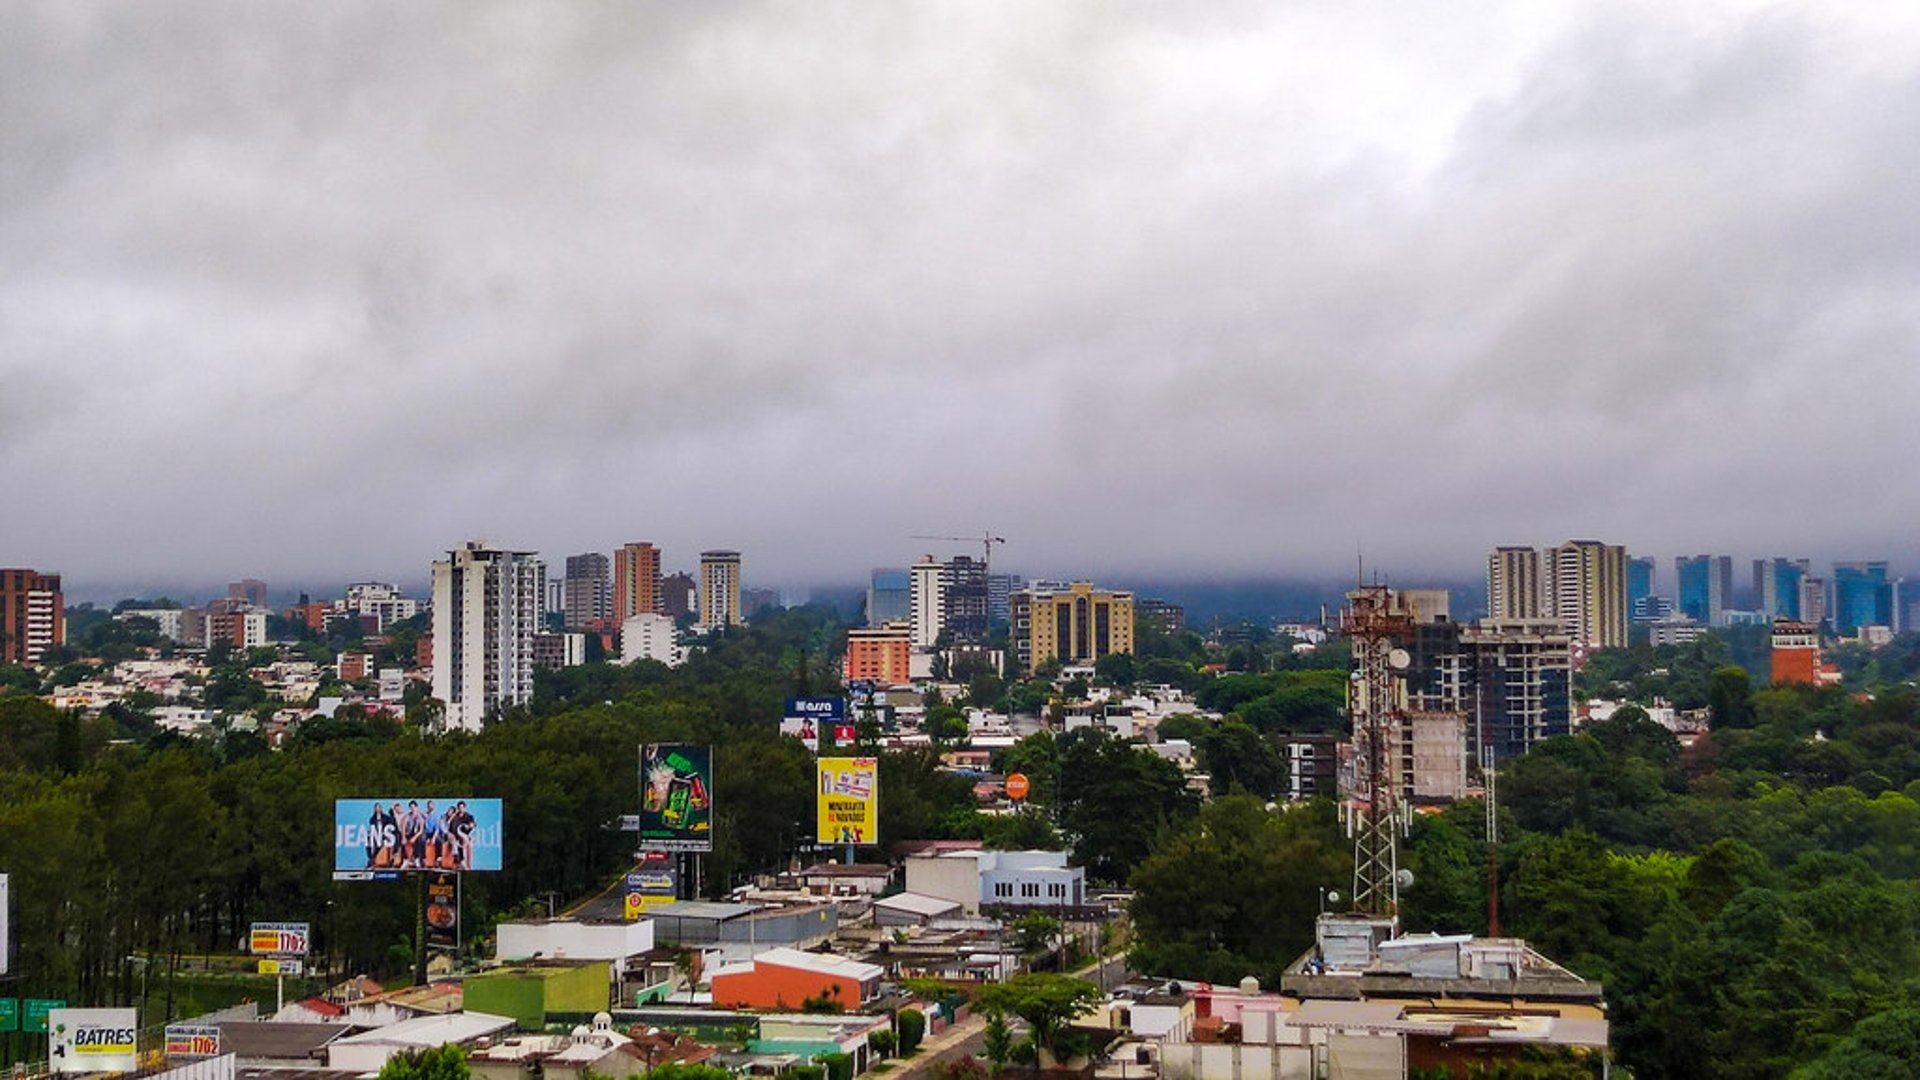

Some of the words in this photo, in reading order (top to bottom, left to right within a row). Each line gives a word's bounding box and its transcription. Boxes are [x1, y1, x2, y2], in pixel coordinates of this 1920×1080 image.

[335, 824, 397, 848] JEANS
[280, 933, 306, 951] 1702
[75, 1028, 134, 1045] BATRES
[193, 1037, 218, 1054] 1702
